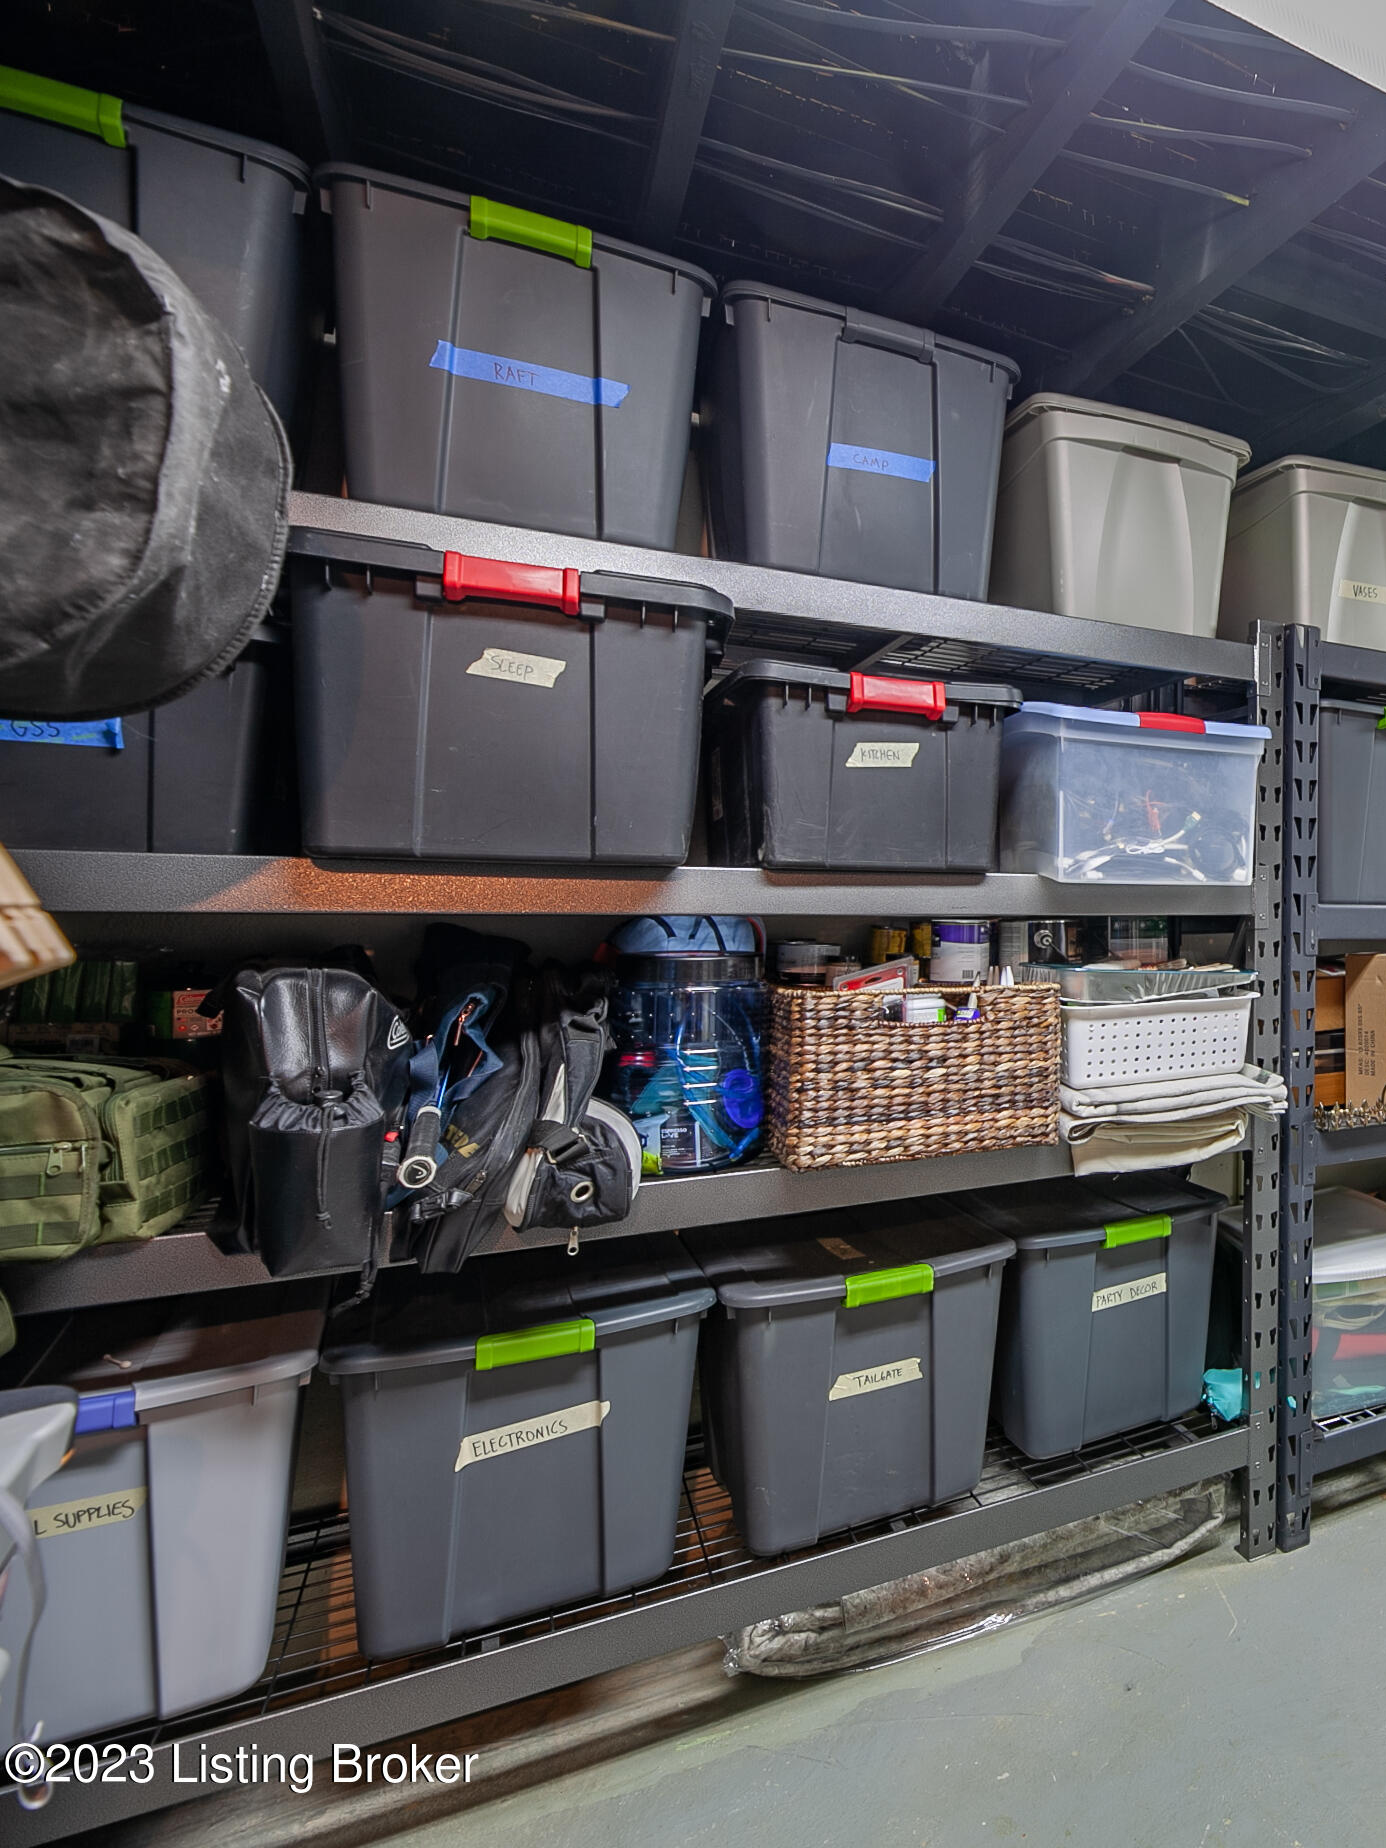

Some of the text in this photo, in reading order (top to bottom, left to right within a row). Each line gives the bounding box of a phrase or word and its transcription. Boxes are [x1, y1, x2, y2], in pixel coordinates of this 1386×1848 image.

[493, 361, 540, 387] RAFT
[853, 453, 889, 471] CAMP
[1352, 584, 1378, 599] VASES
[490, 654, 534, 681] SLEEP
[860, 747, 901, 762] KITCHEN
[1096, 1281, 1158, 1309] PARTY DECOR
[852, 1367, 903, 1389] TAILGATE
[471, 1419, 568, 1458] ELECTRONICS
[33, 1498, 136, 1536] L SUPPLIES
